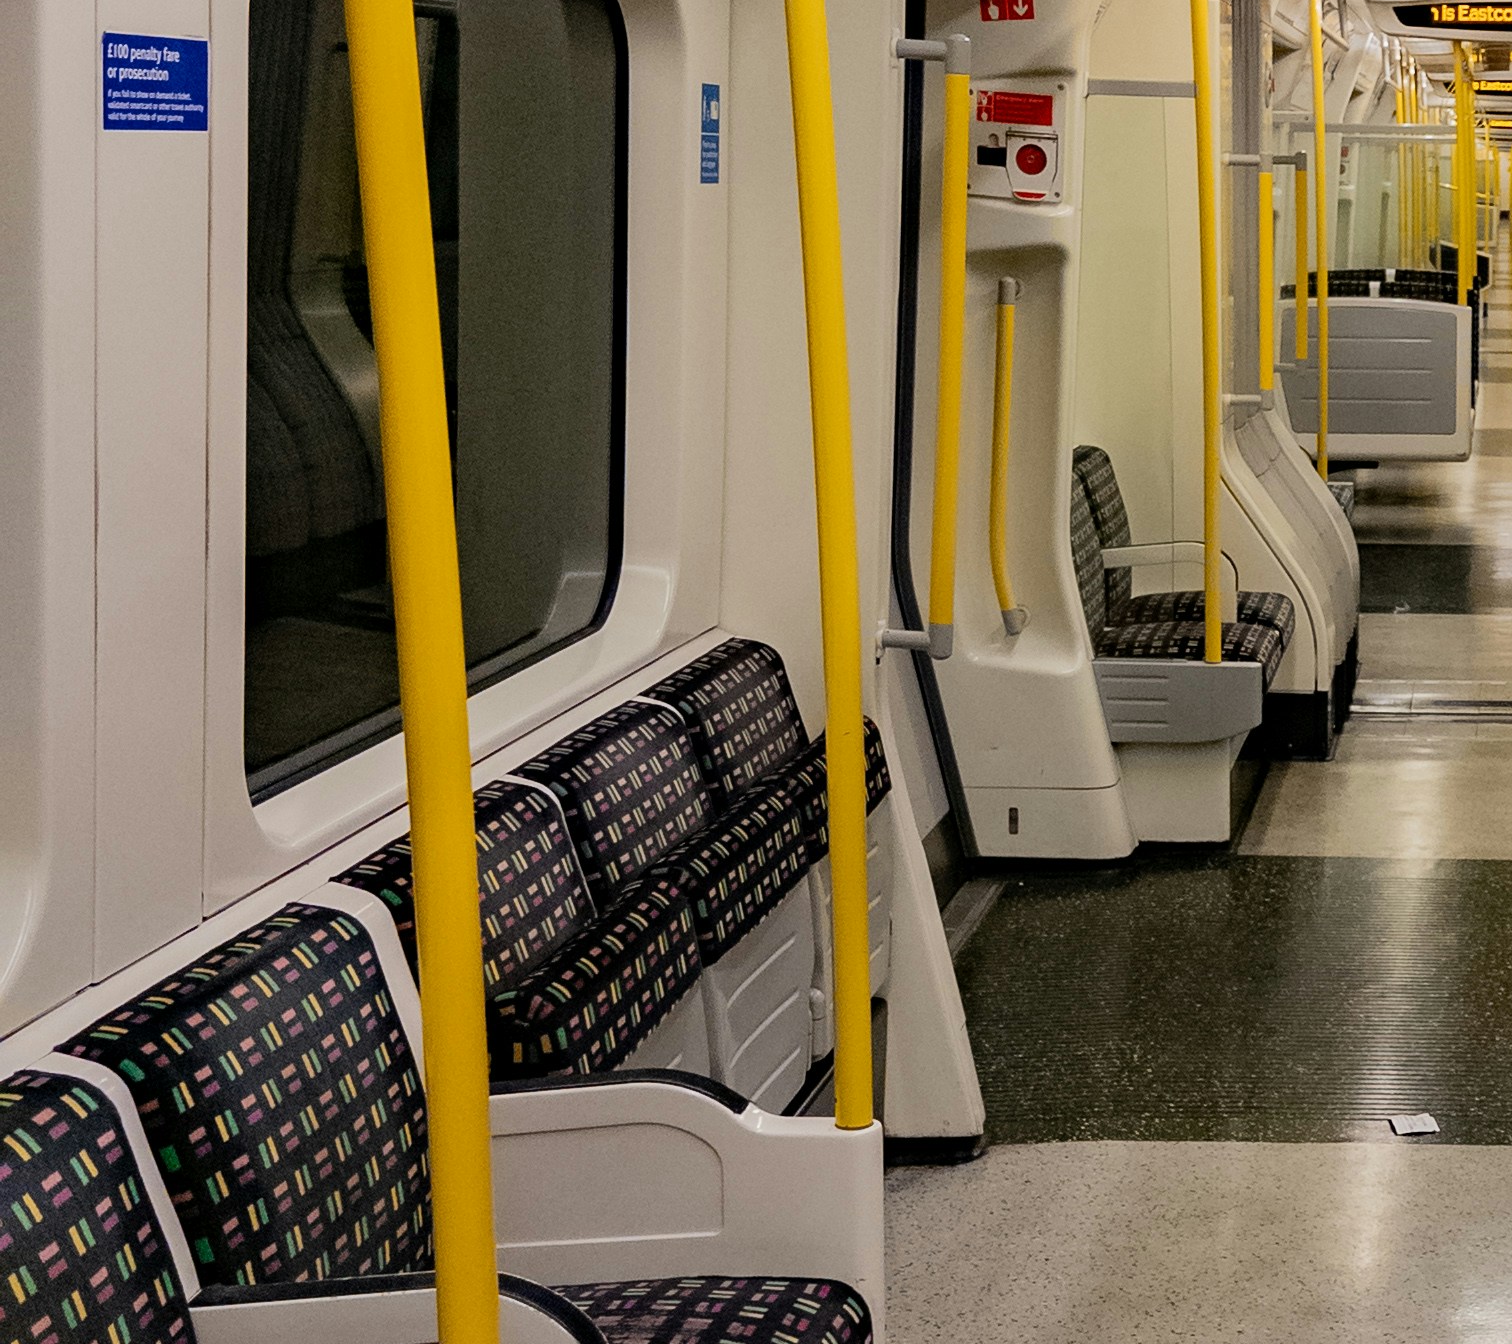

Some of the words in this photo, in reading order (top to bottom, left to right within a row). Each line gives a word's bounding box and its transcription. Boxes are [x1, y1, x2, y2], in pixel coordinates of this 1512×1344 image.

[1441, 5, 1456, 22] is
[107, 43, 129, 59] £100
[130, 46, 162, 65] penalty
[163, 47, 180, 63] fare
[107, 67, 117, 78] or
[118, 67, 169, 83] prosecution
